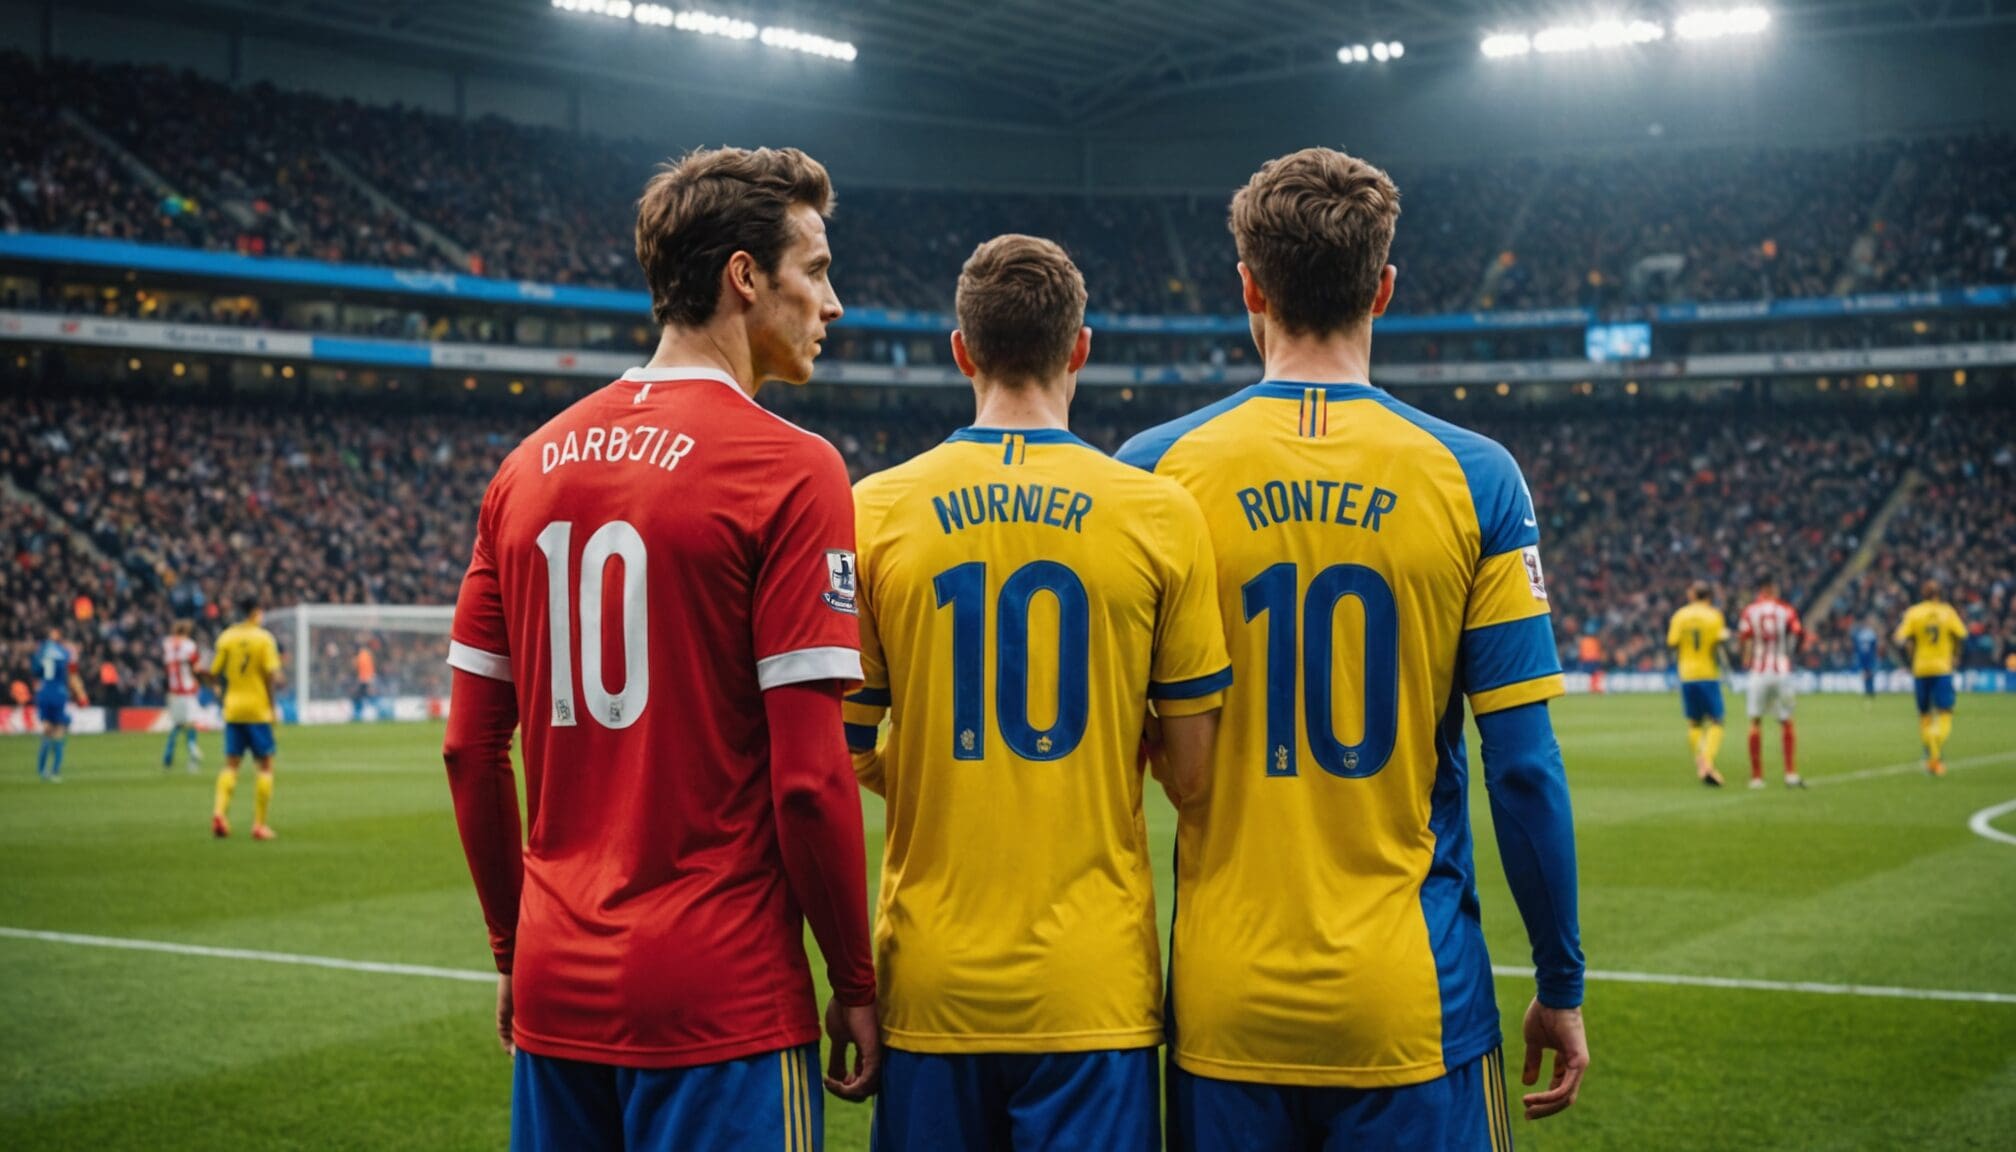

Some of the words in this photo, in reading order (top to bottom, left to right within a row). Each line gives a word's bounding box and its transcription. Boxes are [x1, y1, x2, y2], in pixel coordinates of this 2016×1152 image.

[1236, 480, 1398, 533] RONTER
[536, 520, 649, 729] 10
[933, 560, 1089, 761] 10
[1241, 562, 1399, 778] 10
